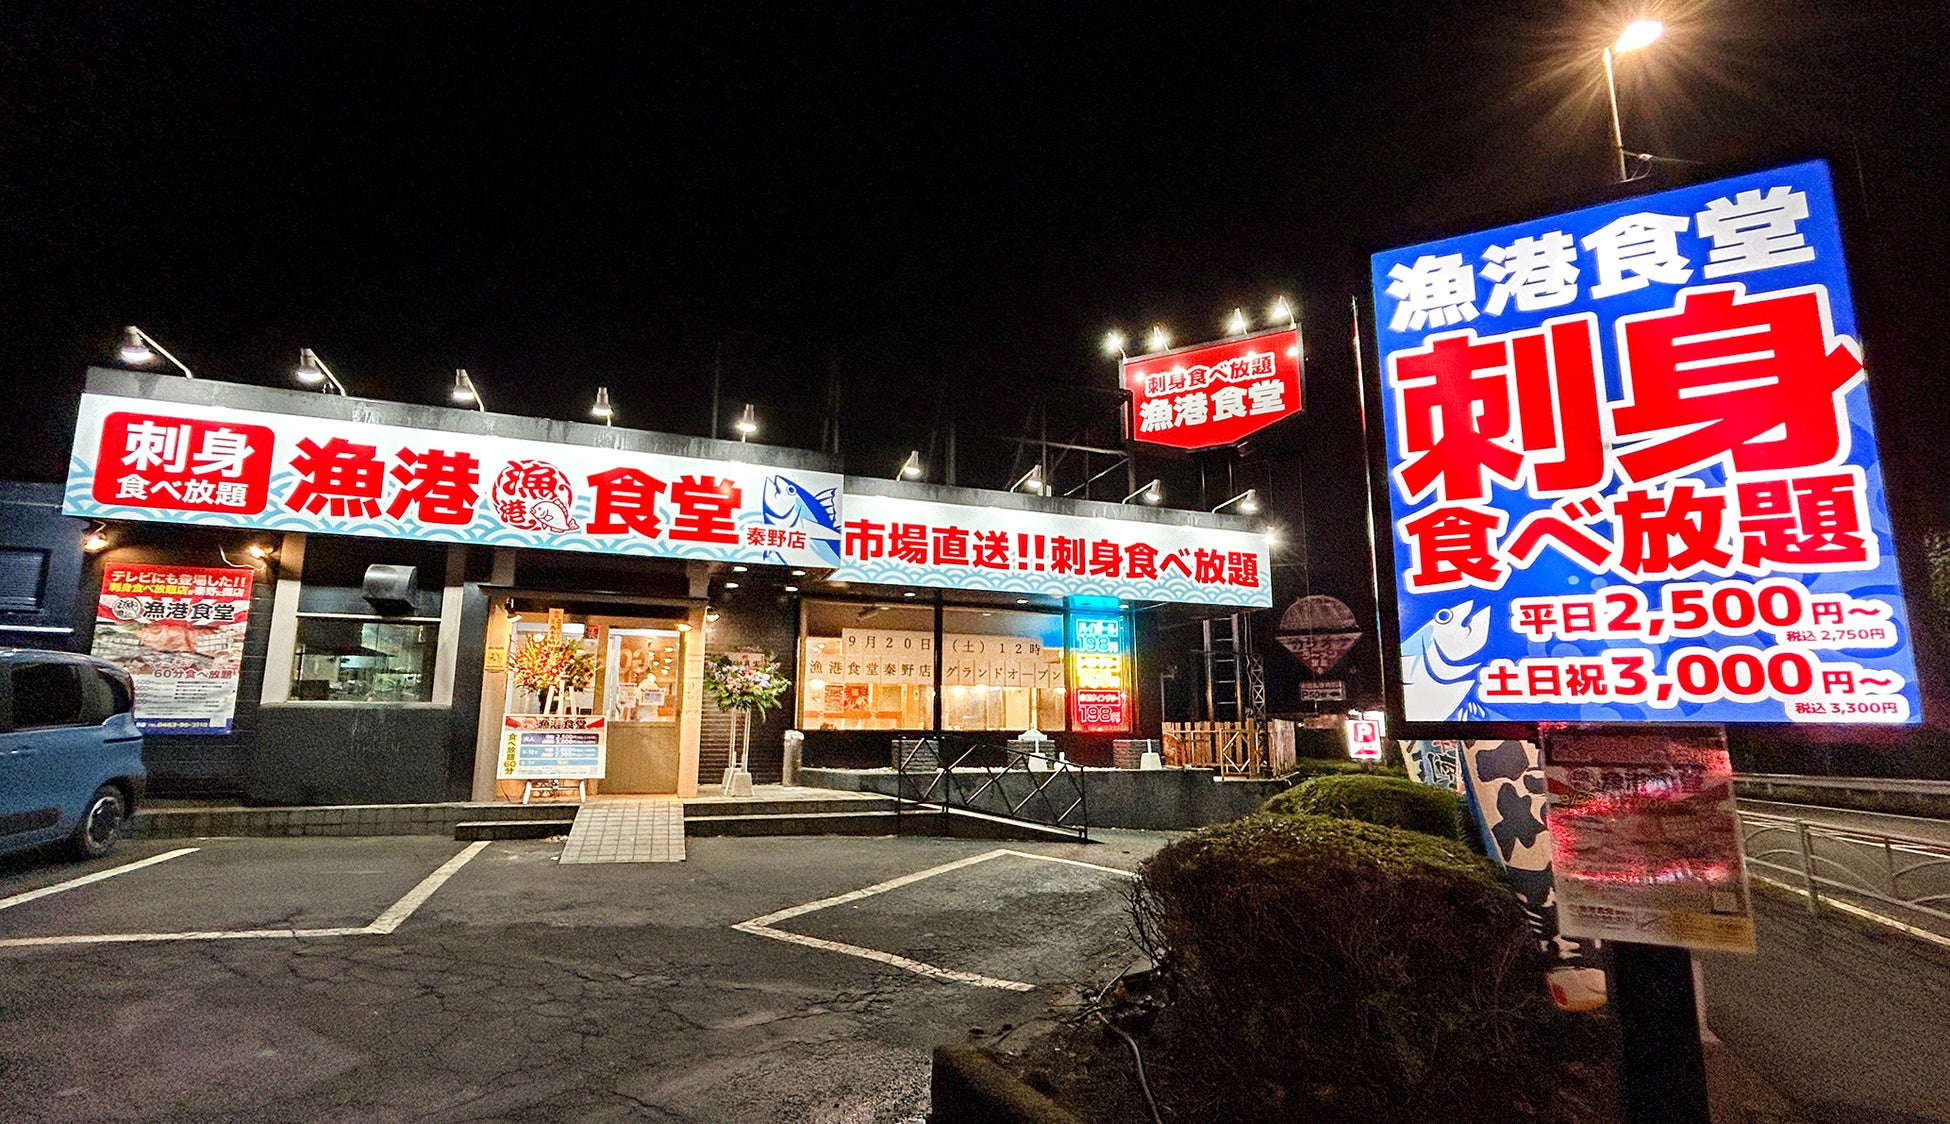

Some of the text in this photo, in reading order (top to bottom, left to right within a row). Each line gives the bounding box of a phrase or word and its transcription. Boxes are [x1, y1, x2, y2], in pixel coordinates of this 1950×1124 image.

[1386, 186, 1816, 333] 漁港食堂
[1148, 356, 1273, 394] 刺身食べ放題
[1396, 290, 1865, 500] 刺身
[1140, 379, 1285, 433] 漁港食堂
[121, 420, 254, 477] 刺身
[115, 476, 249, 508] 食べ放題
[286, 438, 741, 544] 漁港 食堂
[748, 527, 806, 549] 秦野店
[1405, 473, 1867, 587] 食べ放題
[142, 600, 234, 621] 漁港食堂
